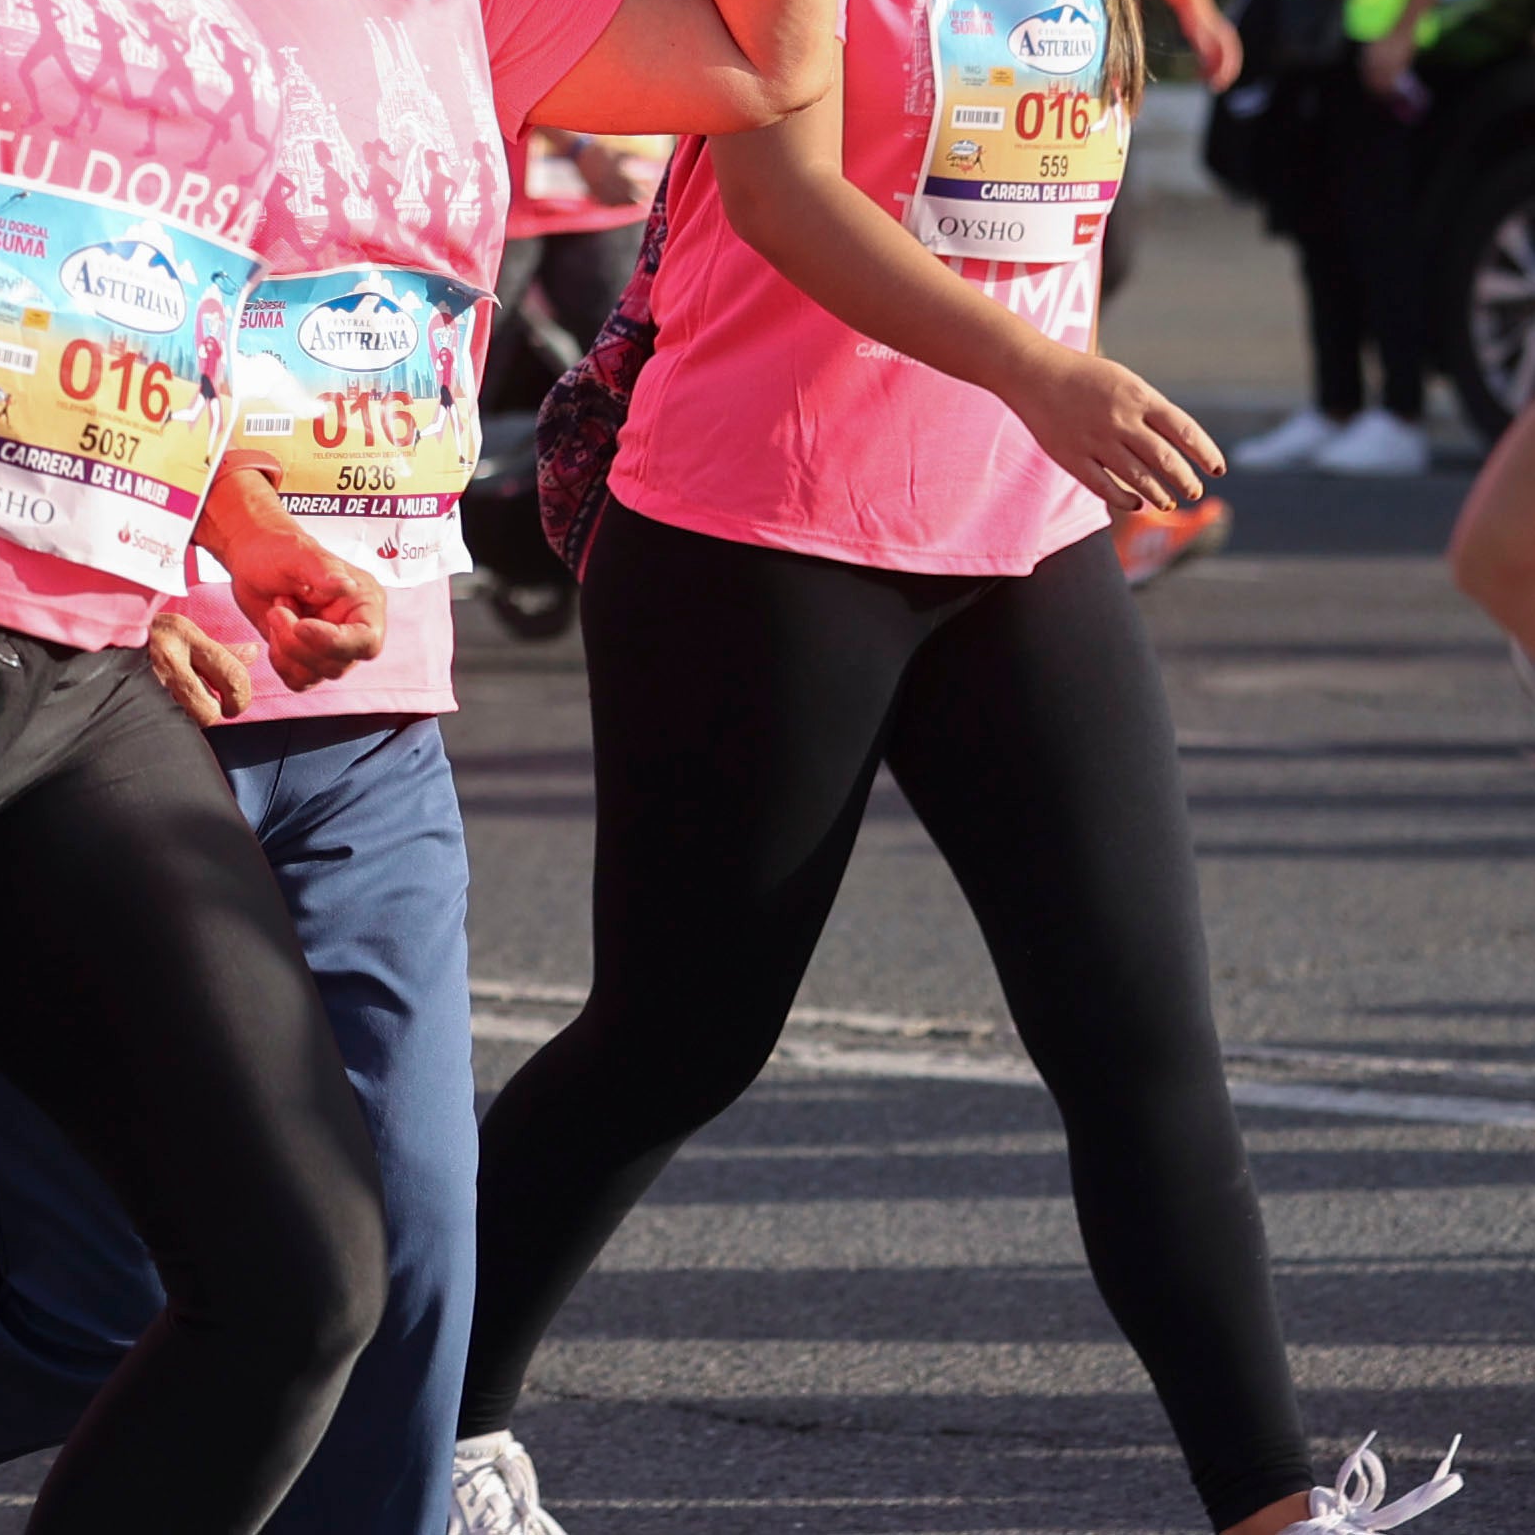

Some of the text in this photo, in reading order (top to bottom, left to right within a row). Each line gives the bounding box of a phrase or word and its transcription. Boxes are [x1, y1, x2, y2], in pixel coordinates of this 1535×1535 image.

[1019, 30, 1093, 57] ASTURIANA
[1014, 92, 1090, 141] 016
[1040, 154, 1069, 177] 559
[980, 183, 1041, 202] CARRERA
[1042, 184, 1057, 202] DE
[1058, 184, 1071, 201] LA
[8, 220, 50, 240] DORSAL
[936, 215, 1025, 243] OYSHO
[73, 260, 179, 322] ASTURIANA
[239, 311, 284, 329] SUMA
[310, 321, 411, 351] ASTURIANA
[58, 338, 174, 424] 016
[312, 391, 418, 450] 016
[79, 423, 140, 464] 5037
[0, 441, 85, 480] CARRERA
[90, 463, 113, 488] DE
[114, 467, 132, 494] LA
[336, 465, 396, 491] 5036
[344, 498, 367, 514] DE
[371, 499, 391, 515] LA
[396, 497, 438, 516] MUJER
